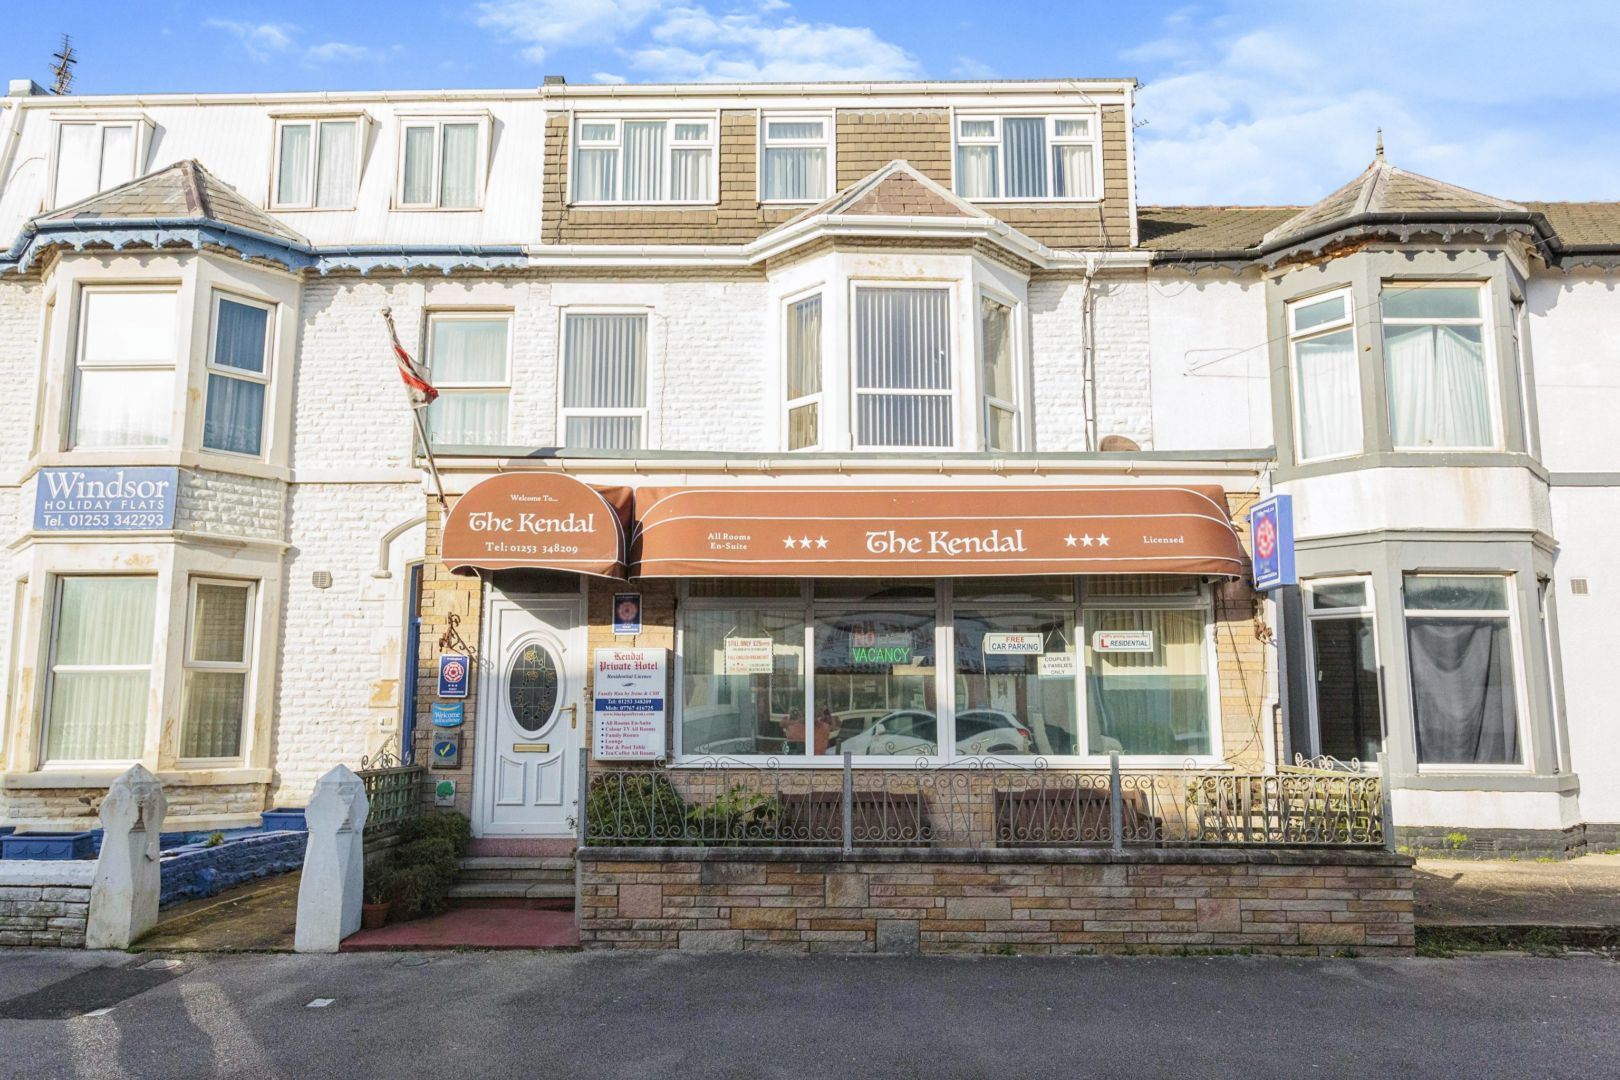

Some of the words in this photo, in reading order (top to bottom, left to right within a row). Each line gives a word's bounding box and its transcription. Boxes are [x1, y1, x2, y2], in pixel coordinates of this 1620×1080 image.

[44, 471, 169, 499] Windsor
[510, 494, 541, 502] Welcome
[44, 500, 112, 510] HOLIDAY
[121, 500, 165, 510] FLATS
[44, 515, 64, 527] Tel.
[69, 514, 110, 526] 01253
[114, 514, 164, 526] 342293
[468, 511, 514, 533] The
[516, 512, 597, 535] Kendal
[707, 533, 721, 541] All
[723, 533, 751, 541] Rooms
[1143, 535, 1184, 544] Licensed
[710, 542, 748, 551] En-Suite
[866, 530, 922, 554] The
[927, 529, 1027, 556] Kendal
[485, 542, 508, 552] Tel:
[510, 544, 537, 554] 01253
[542, 543, 578, 554] 348209
[991, 643, 1007, 651] CAR
[1008, 643, 1039, 651] PARKING
[614, 651, 644, 661] Kendal
[852, 647, 910, 663] VACANCY
[599, 661, 631, 672] Private
[634, 661, 658, 670] Hotel
